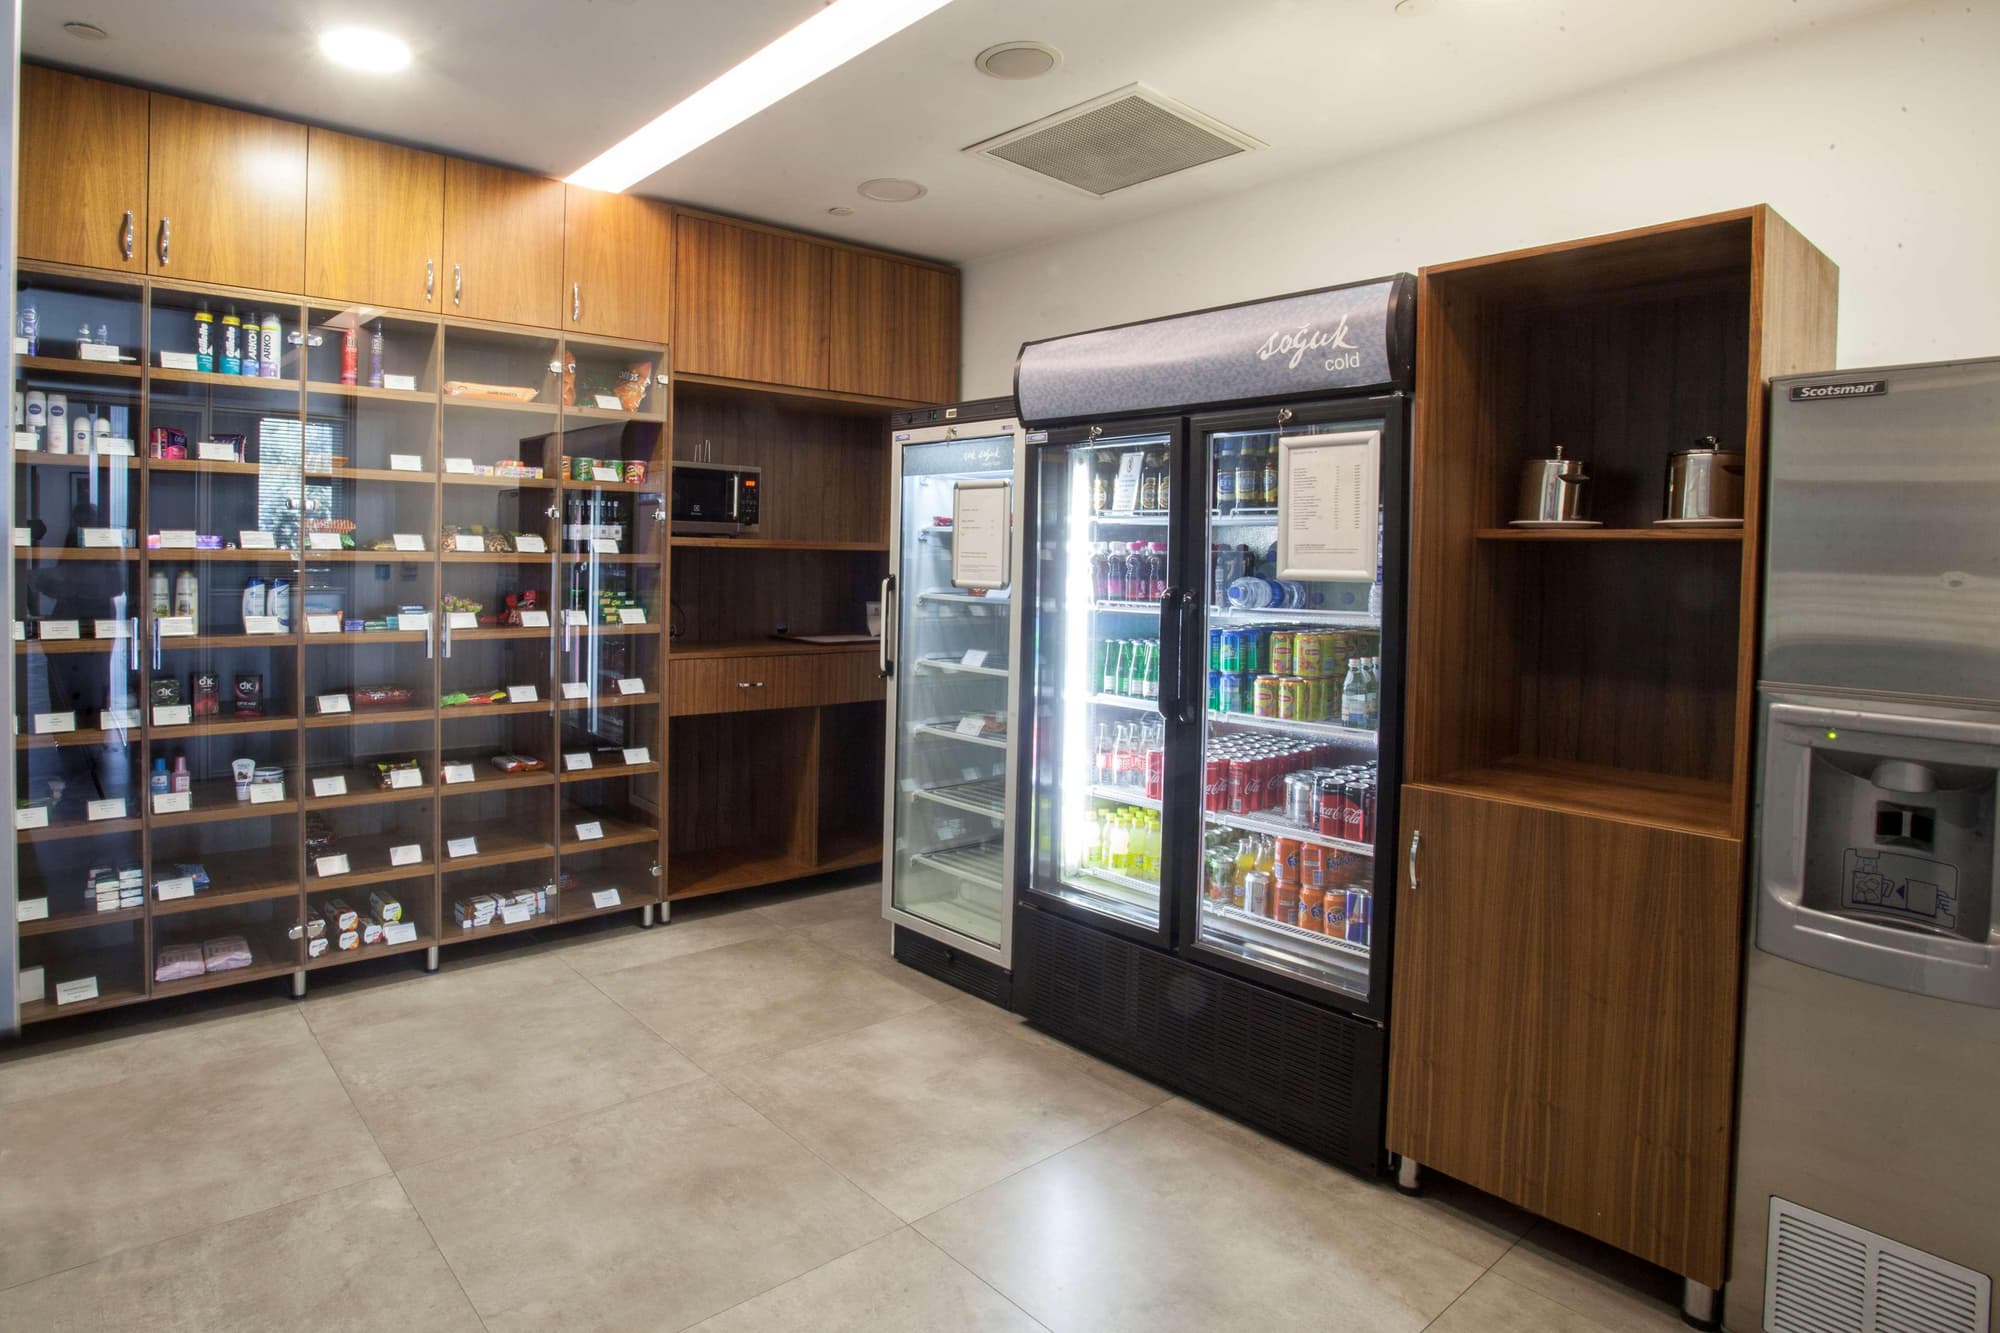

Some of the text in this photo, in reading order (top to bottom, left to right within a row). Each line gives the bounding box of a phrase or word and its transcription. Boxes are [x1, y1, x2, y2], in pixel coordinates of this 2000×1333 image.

[248, 333, 257, 360] ARKO
[263, 334, 272, 360] ARKO
[1256, 314, 1359, 369] soğuk
[1325, 351, 1360, 371] cold
[1800, 384, 1875, 397] Scotsman
